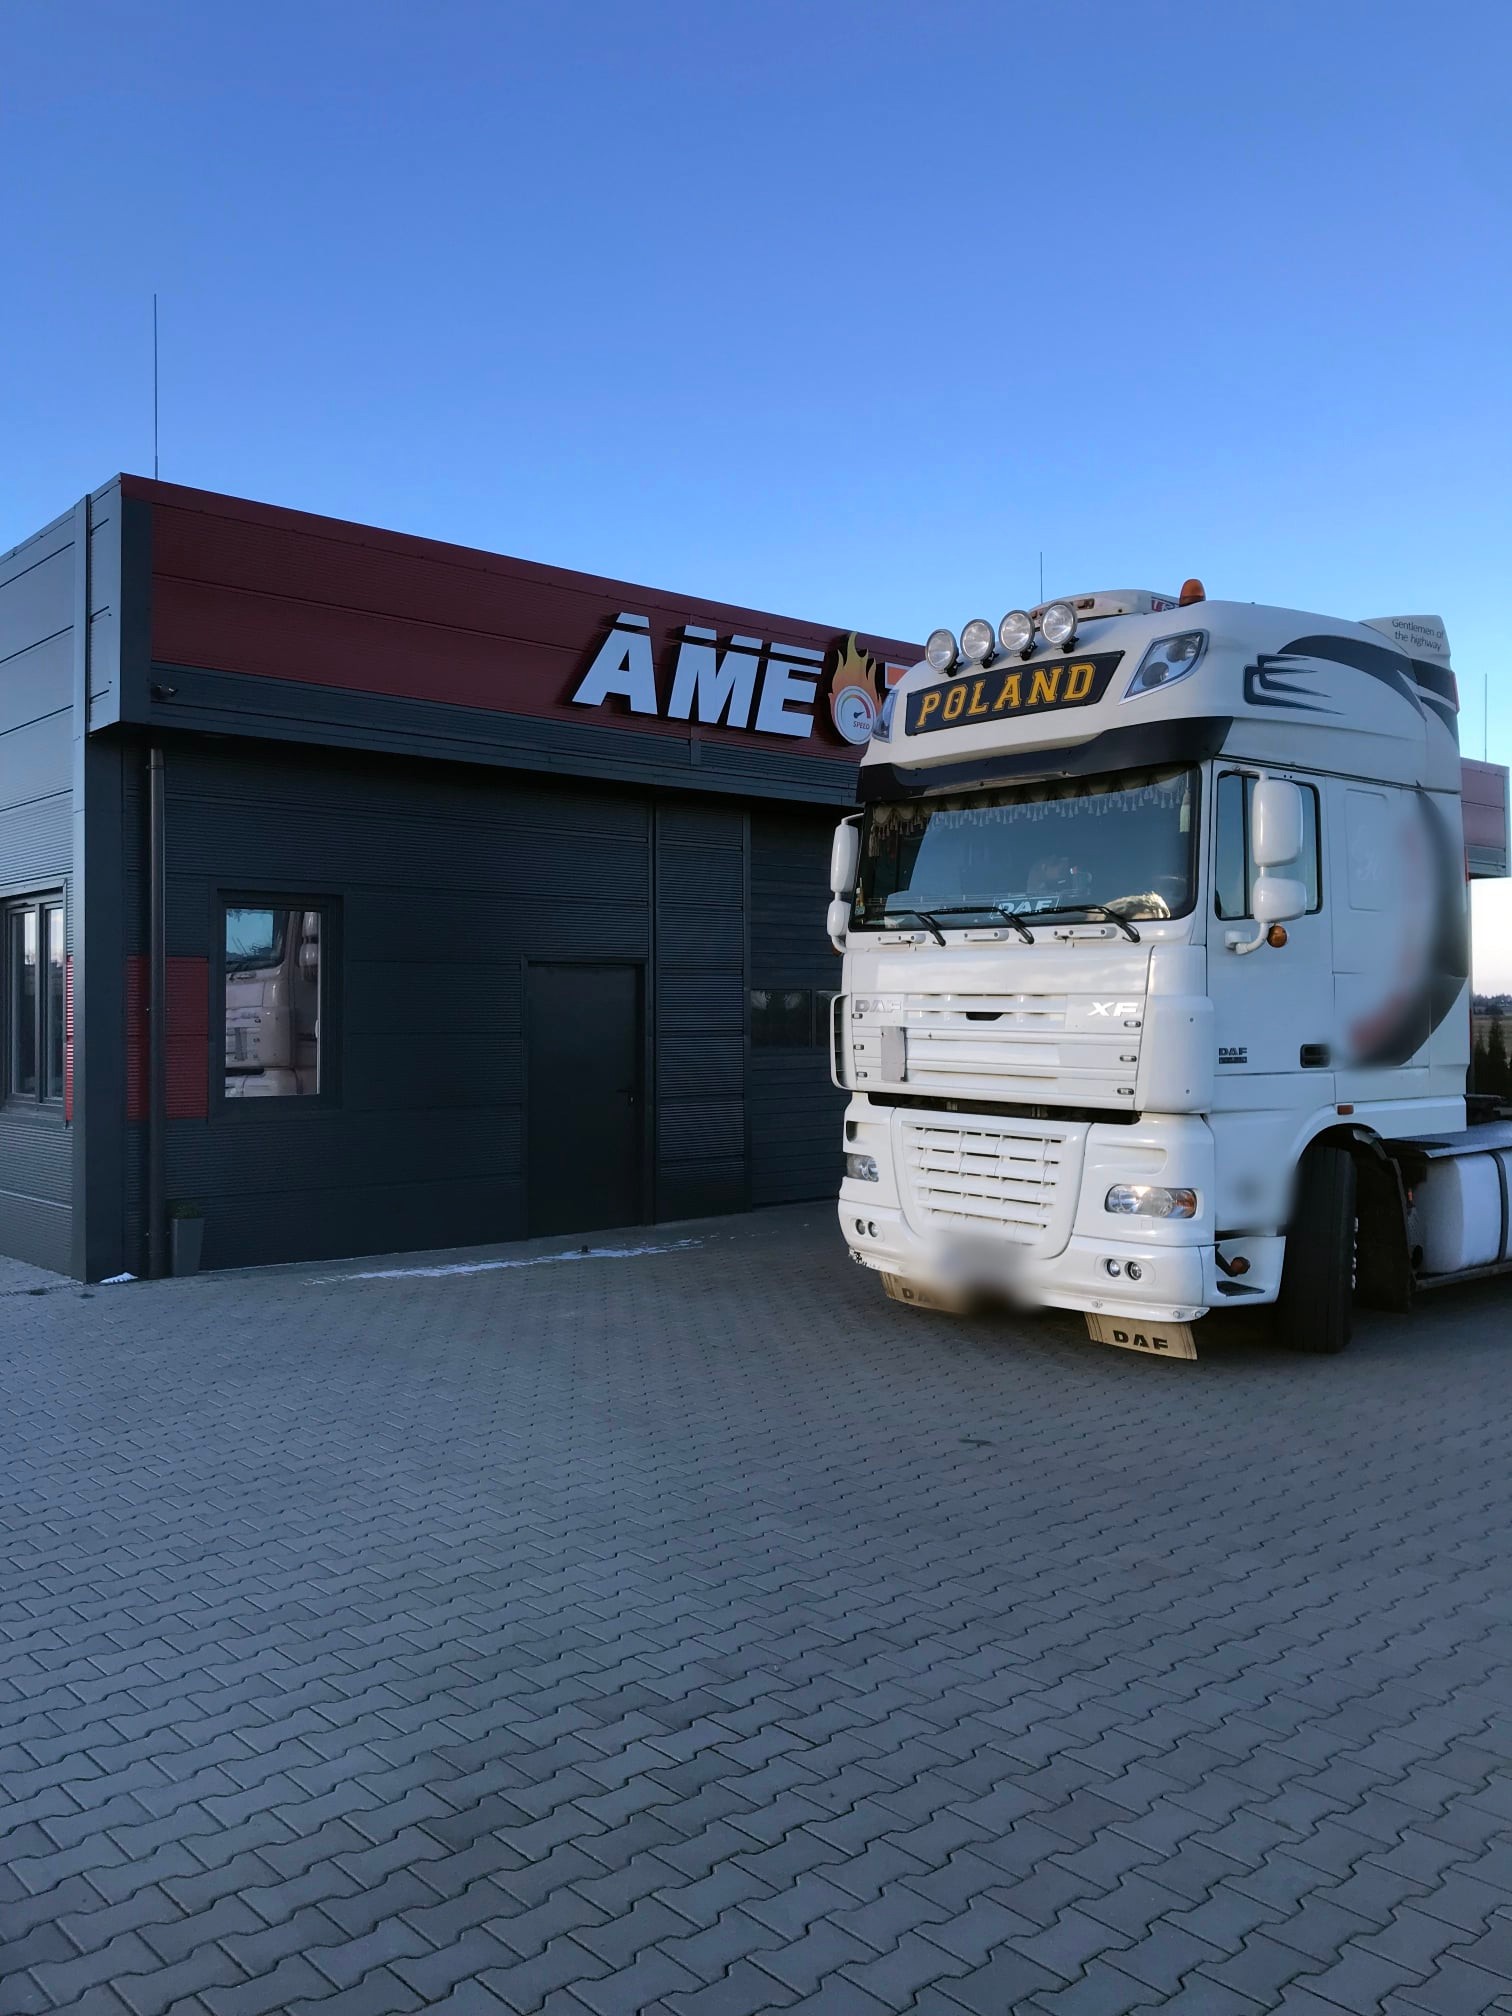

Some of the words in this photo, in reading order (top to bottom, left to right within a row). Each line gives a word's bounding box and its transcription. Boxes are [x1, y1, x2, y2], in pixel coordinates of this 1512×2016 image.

[1391, 618, 1434, 637] Gentlemen
[1436, 628, 1444, 639] of
[1394, 630, 1409, 641] the
[1410, 633, 1442, 653] highway
[572, 611, 825, 738] AME
[914, 662, 1097, 728] POLAND
[998, 900, 1053, 915] DAF
[855, 999, 902, 1013] DAF
[1087, 1001, 1139, 1017] XF
[1218, 1047, 1248, 1057] DAF
[1113, 1329, 1169, 1350] DAF
